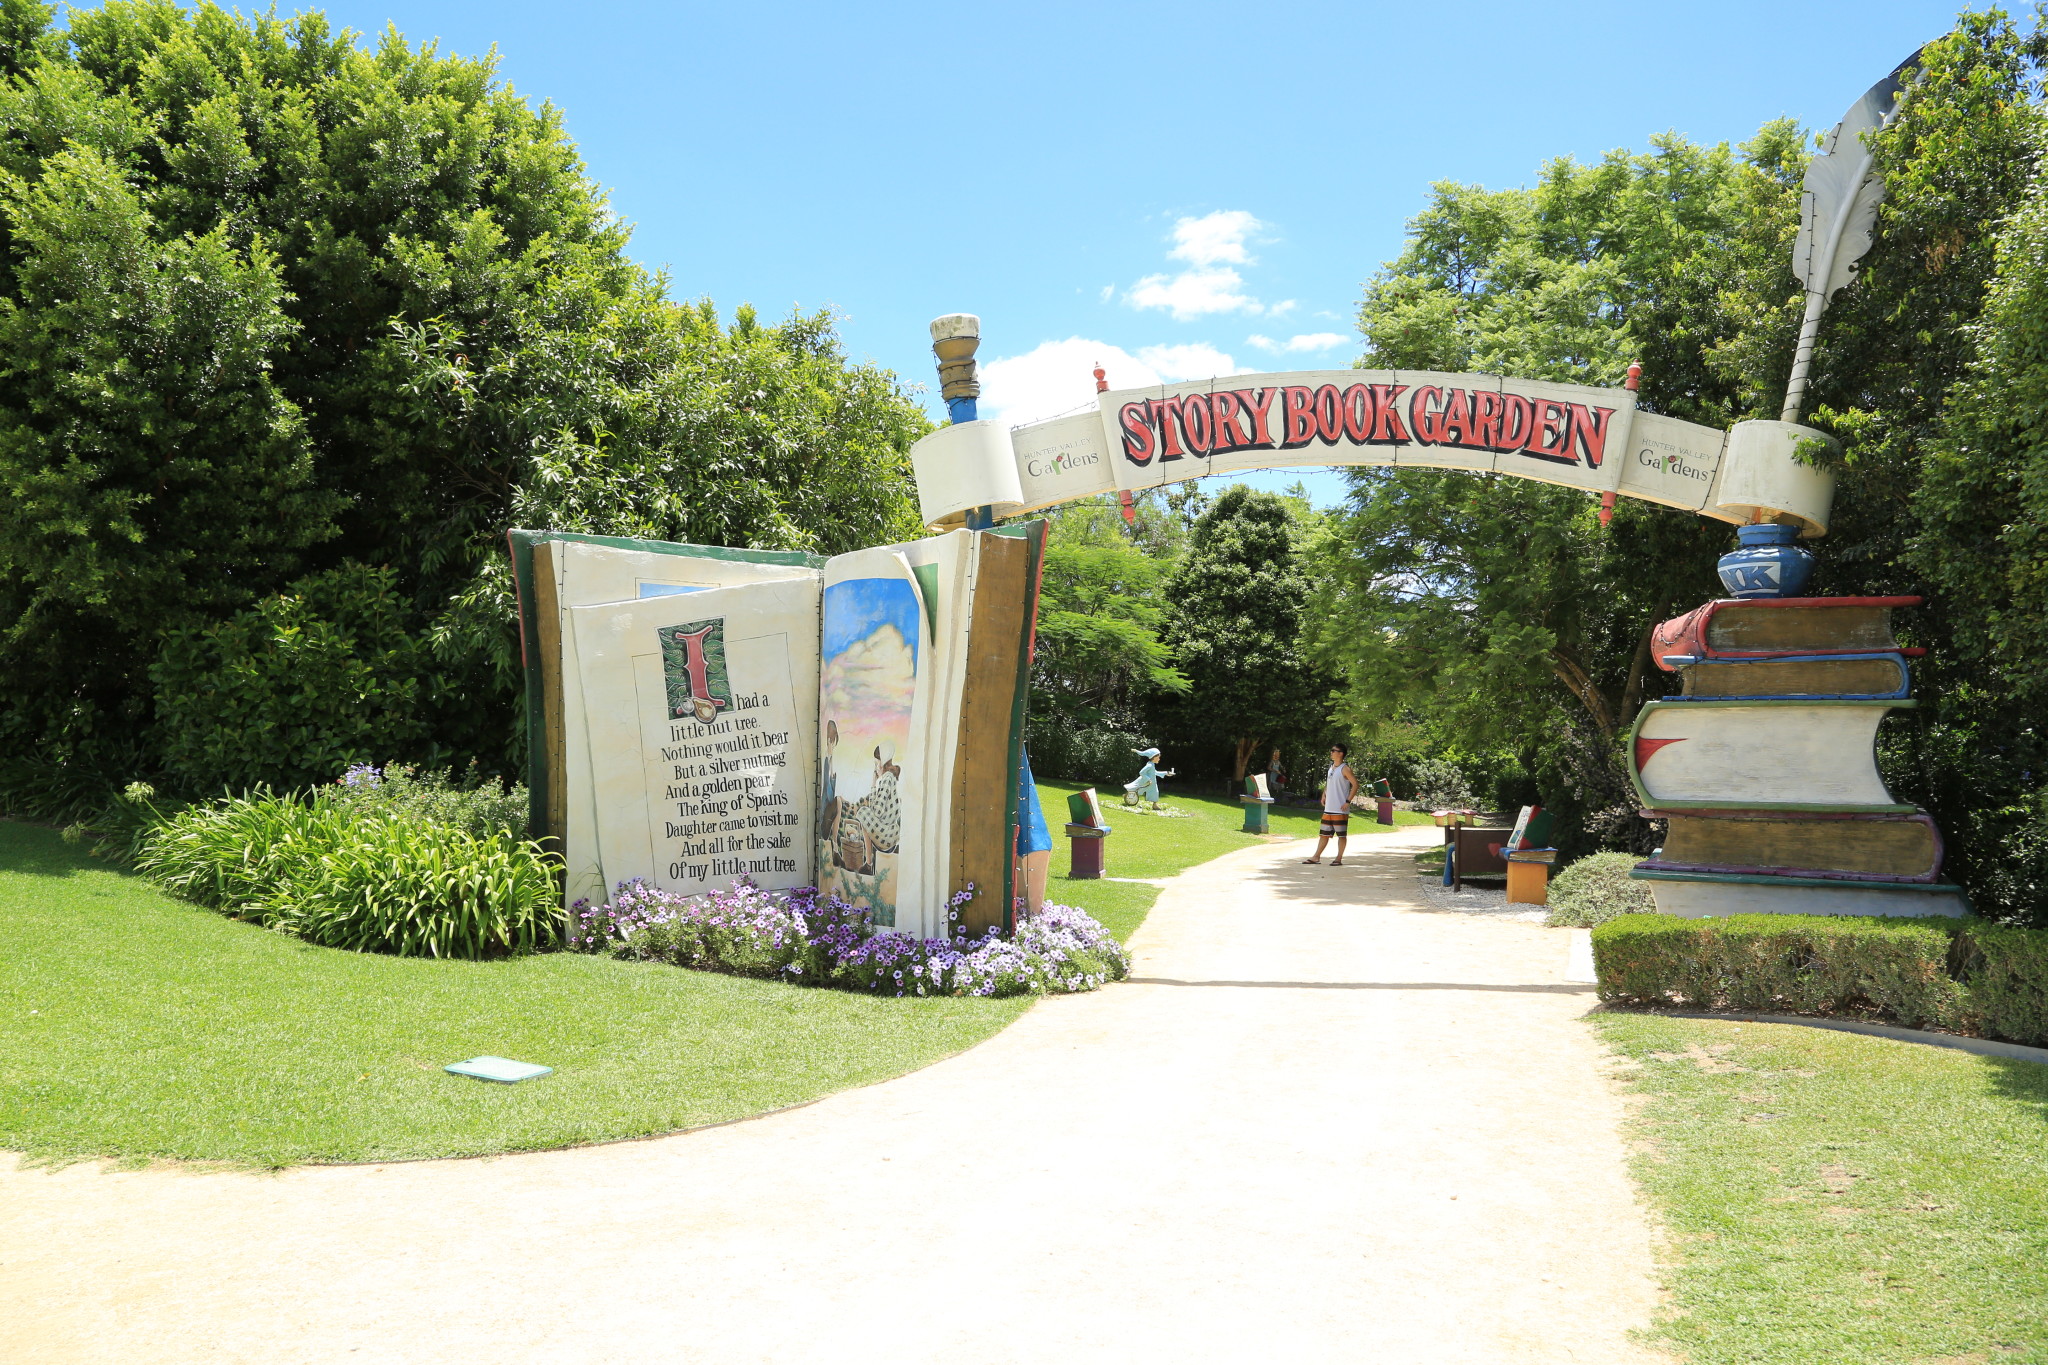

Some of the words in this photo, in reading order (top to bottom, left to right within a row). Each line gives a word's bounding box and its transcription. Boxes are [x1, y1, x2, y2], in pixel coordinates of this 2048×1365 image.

[1119, 386, 1277, 467] STORY
[1280, 383, 1413, 449] BOOK
[1409, 384, 1616, 468] GARDEN
[1024, 446, 1057, 460] HUNTER
[1060, 437, 1091, 451] VALLEY
[1642, 438, 1676, 453] HUNTER
[1679, 447, 1713, 461] VALLEY
[1027, 452, 1099, 477] Gardens
[1639, 448, 1709, 481] Gardens
[736, 692, 760, 711] had
[762, 694, 771, 707] a
[670, 722, 705, 742] little
[707, 720, 733, 736] nut
[661, 743, 714, 763] Nothing
[715, 735, 750, 755] would
[750, 733, 763, 749] it
[762, 731, 789, 748] bear
[674, 764, 698, 781] But
[698, 764, 708, 777] a
[709, 757, 741, 775] silver
[743, 751, 787, 768] nutmeg
[665, 783, 690, 800] And
[692, 785, 701, 797] a
[702, 777, 743, 800] golden
[744, 775, 775, 794] pear.
[677, 801, 699, 818] The
[699, 799, 729, 817] King
[730, 794, 744, 811] of
[746, 790, 789, 812] Spain's
[665, 820, 717, 839] Daughter
[719, 818, 745, 832] came
[746, 814, 759, 828] to
[759, 810, 784, 827] visit
[784, 813, 799, 826] me
[680, 839, 707, 858] And
[709, 837, 724, 854] all
[727, 835, 744, 852] for
[746, 833, 765, 850] the
[766, 832, 791, 849] sake
[669, 861, 688, 880] Of
[688, 864, 709, 882] my
[711, 857, 747, 876] little
[749, 856, 772, 873] nut
[774, 856, 797, 872] tree.
